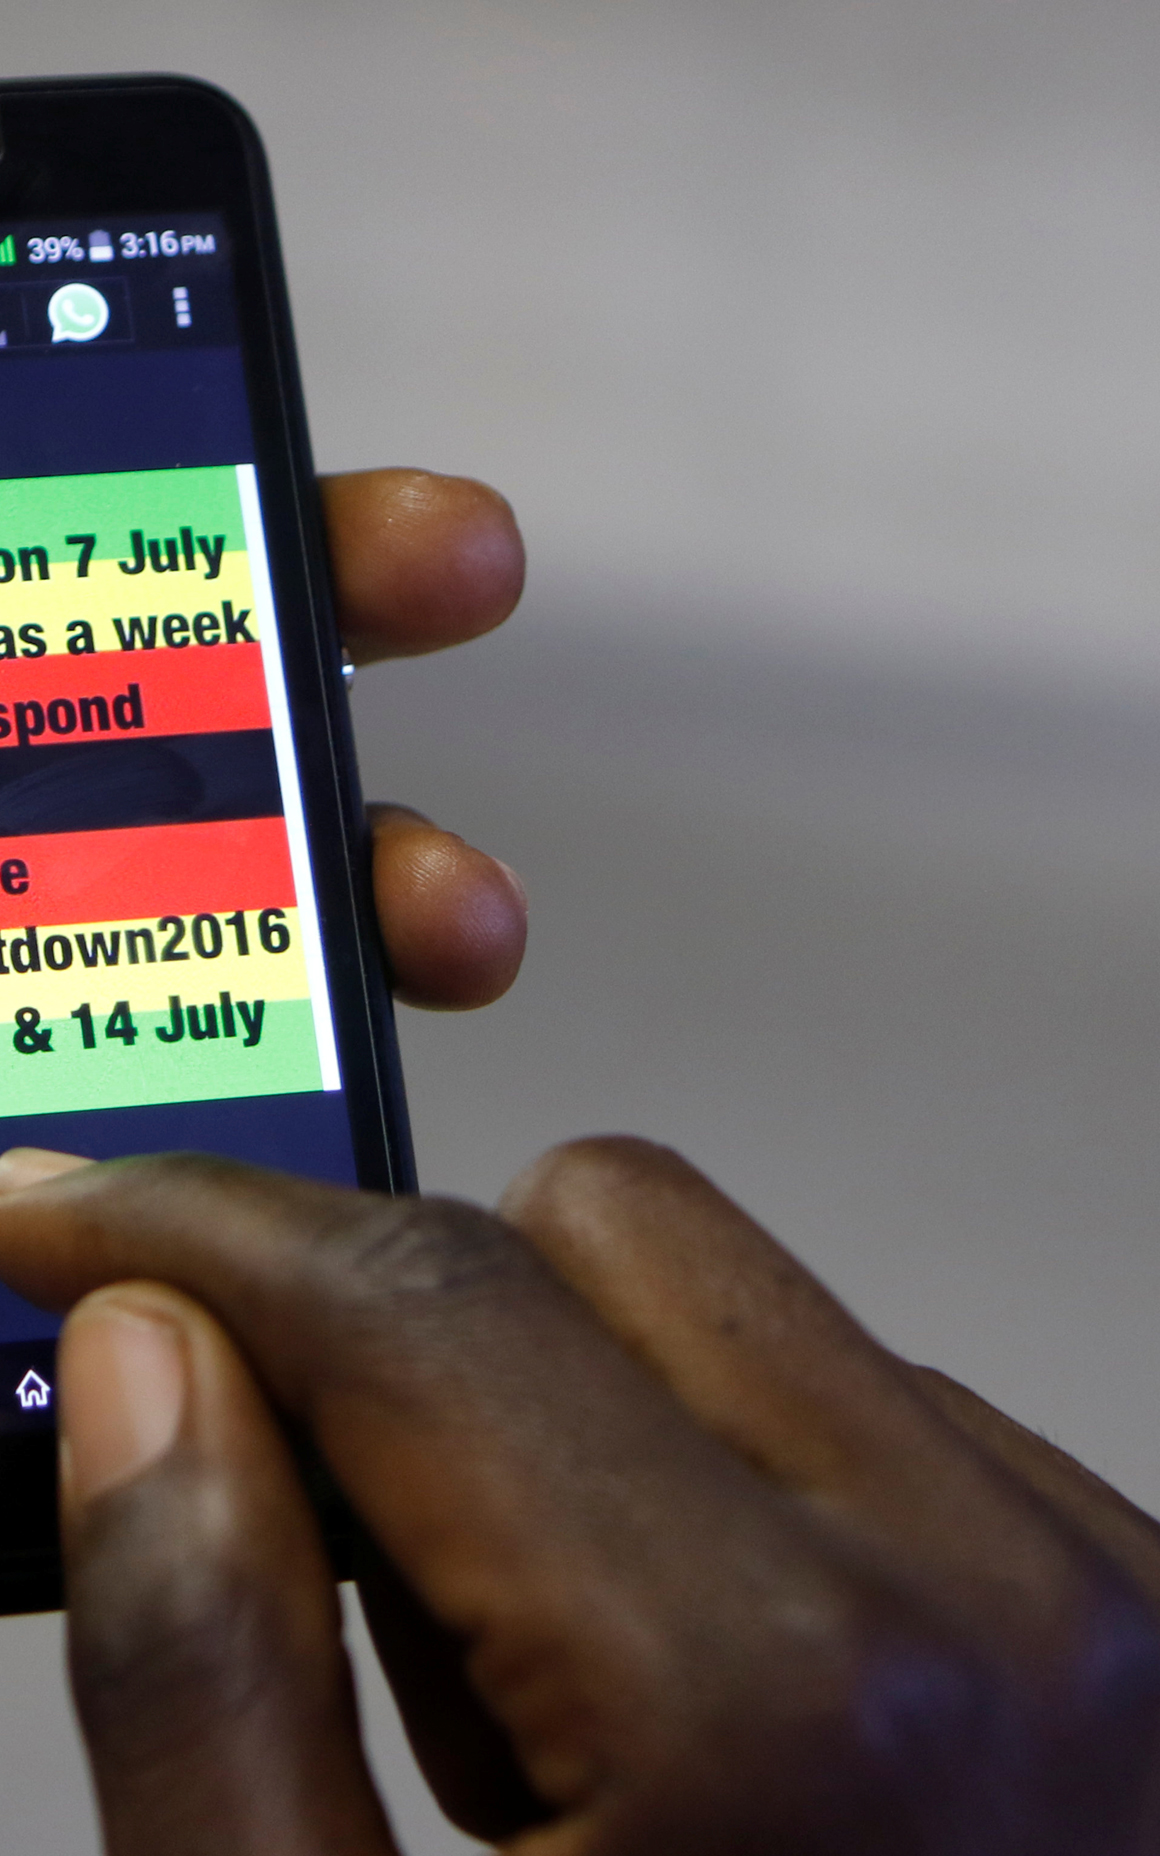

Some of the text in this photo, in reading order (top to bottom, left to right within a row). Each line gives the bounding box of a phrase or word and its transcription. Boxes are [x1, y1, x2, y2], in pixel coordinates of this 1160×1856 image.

[27, 235, 84, 264] 39%
[66, 534, 97, 579] 7
[119, 526, 226, 580] July
[66, 617, 96, 655] a
[113, 601, 254, 651] week
[12, 1006, 55, 1053] &
[71, 1001, 137, 1048] 14
[155, 991, 267, 1047] July
